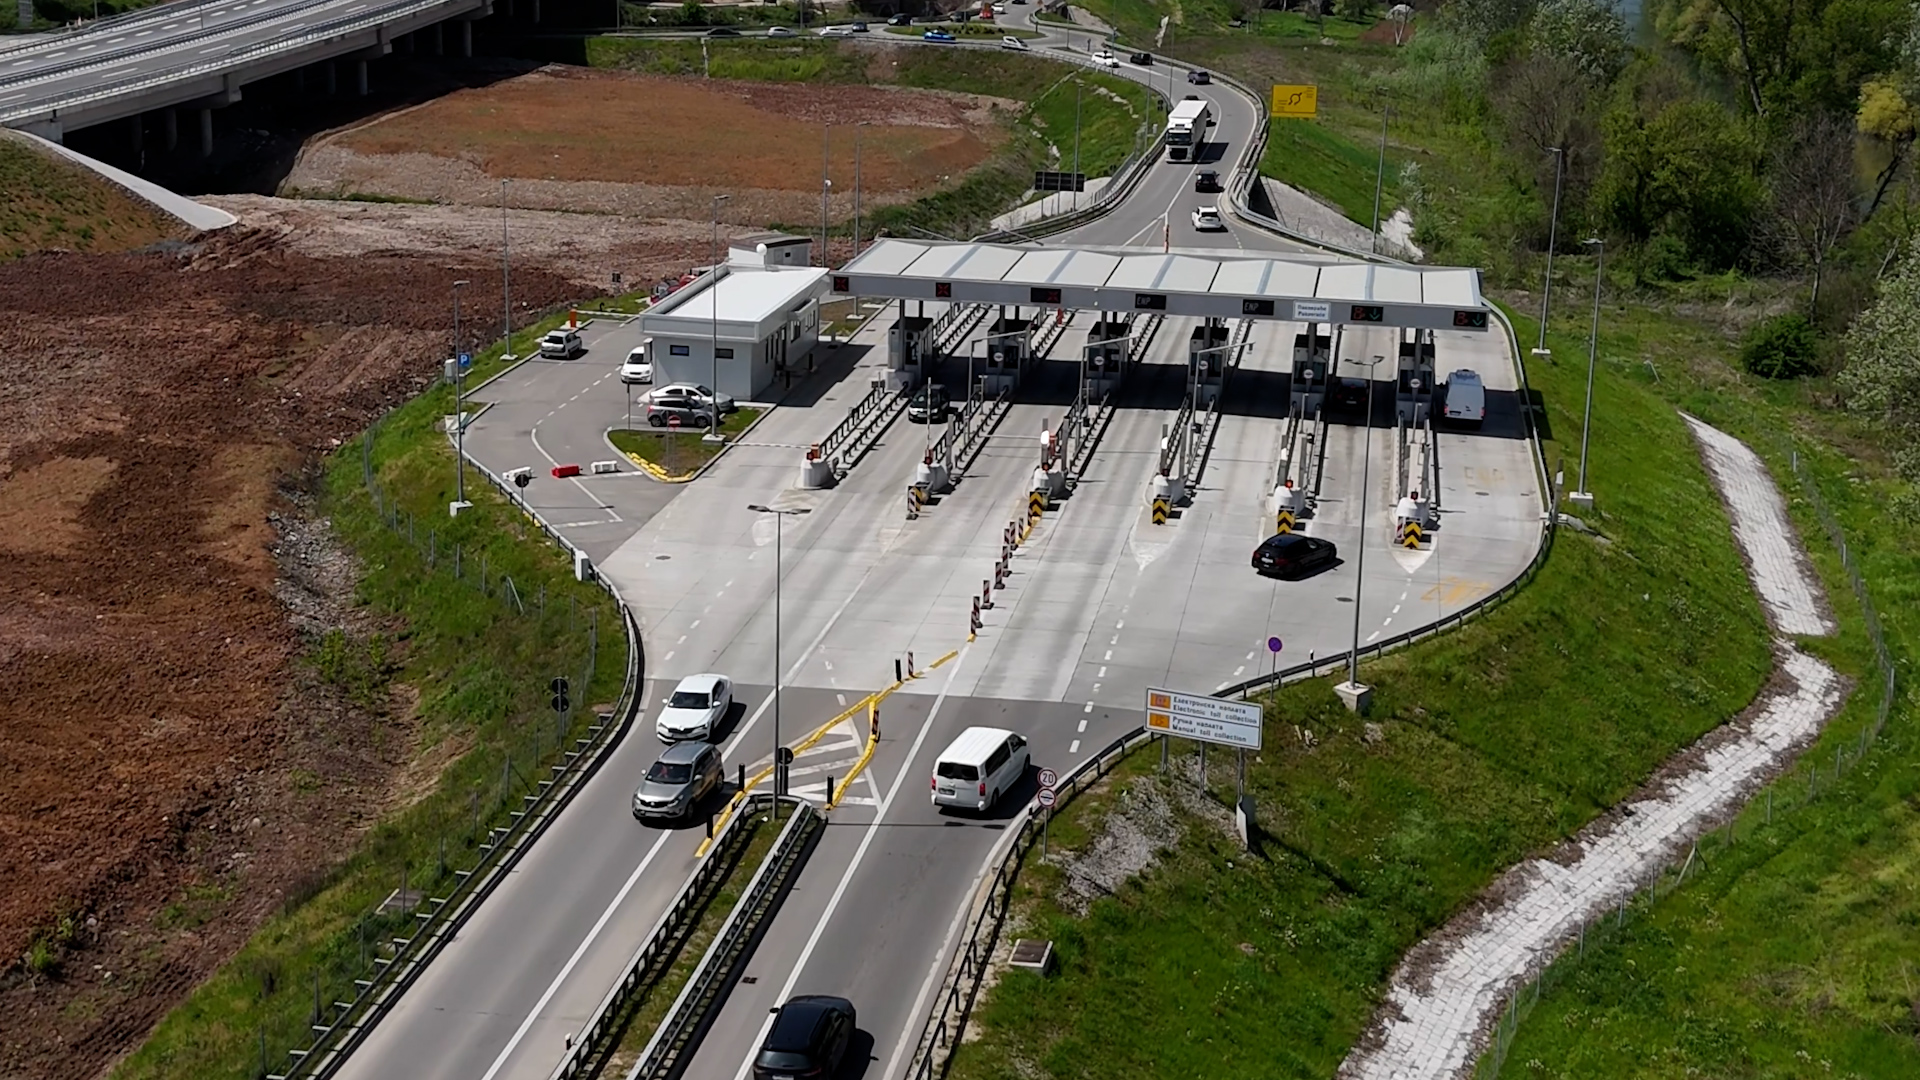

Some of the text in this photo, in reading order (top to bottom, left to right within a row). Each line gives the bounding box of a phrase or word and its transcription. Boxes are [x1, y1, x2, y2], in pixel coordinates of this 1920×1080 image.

[460, 355, 468, 364] P
[1174, 697, 1246, 714] Електронска наплата
[1173, 716, 1192, 725] Ручна
[1174, 705, 1205, 715] Electronic
[1226, 714, 1257, 724] collection
[1173, 724, 1195, 733] Manual
[1214, 732, 1246, 741] collection
[1043, 773, 1053, 783] 20
